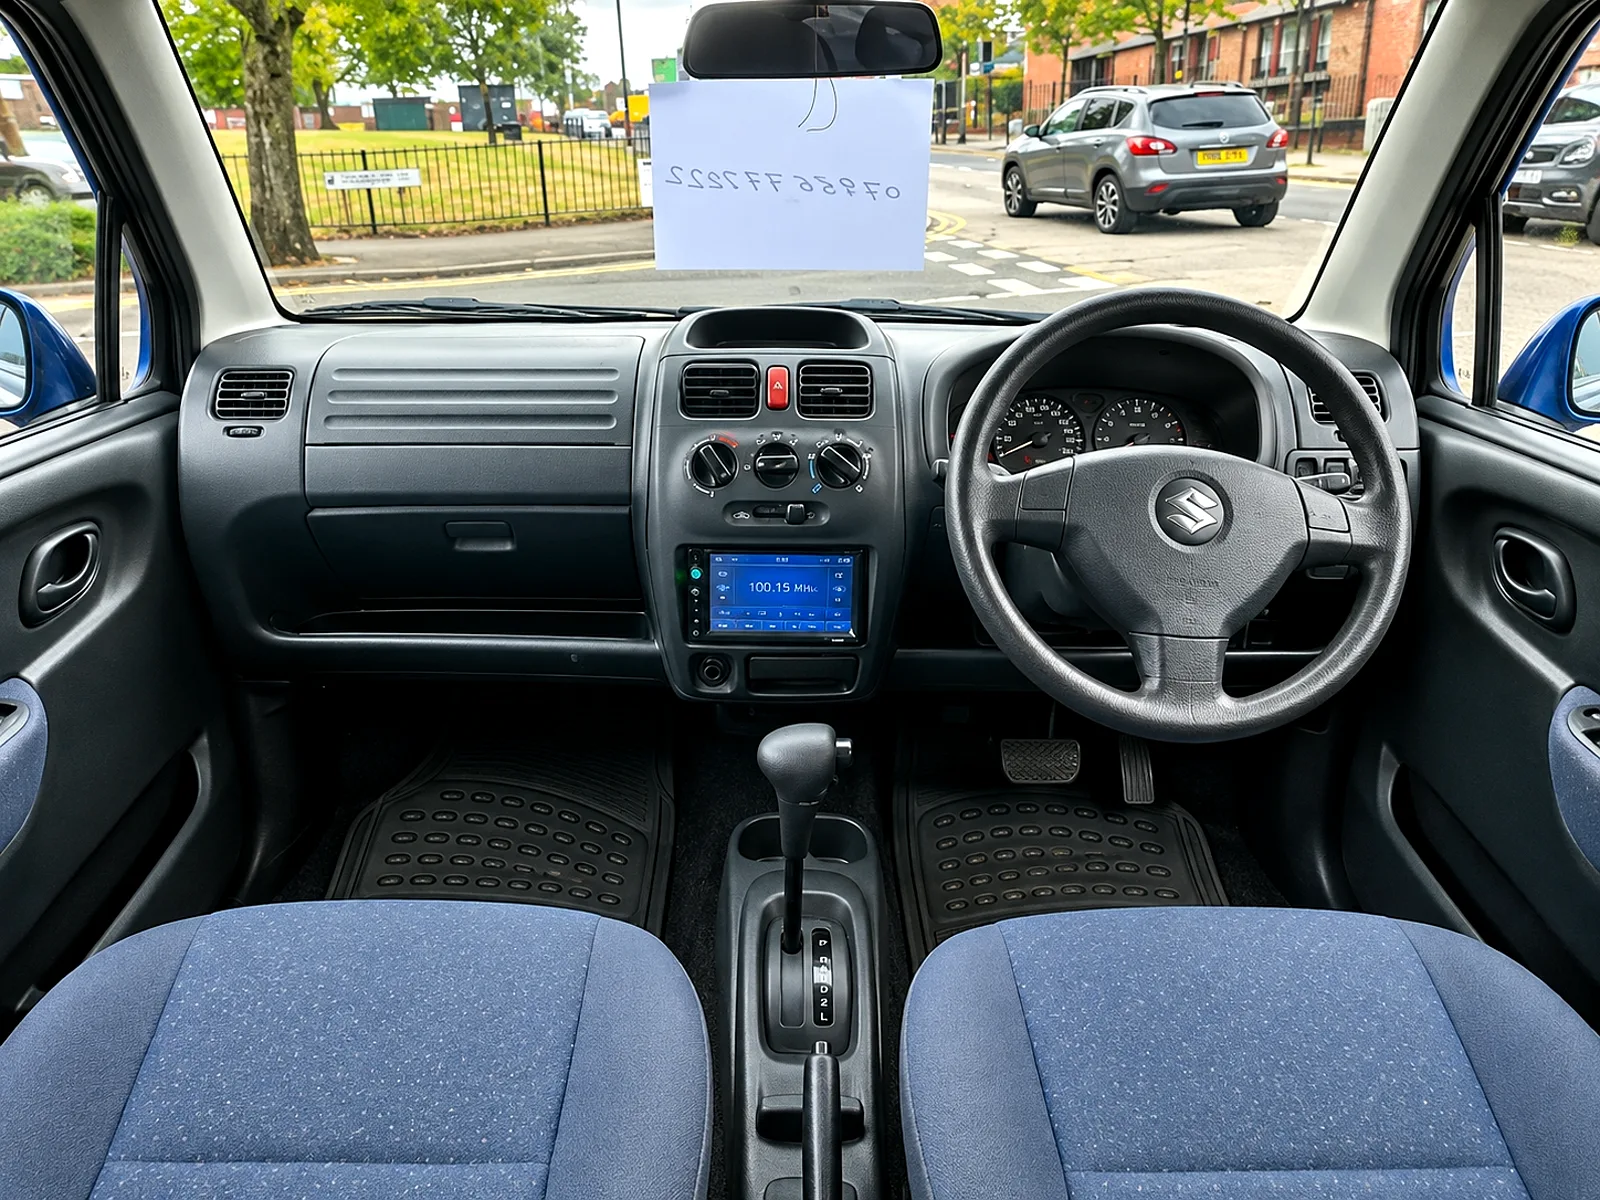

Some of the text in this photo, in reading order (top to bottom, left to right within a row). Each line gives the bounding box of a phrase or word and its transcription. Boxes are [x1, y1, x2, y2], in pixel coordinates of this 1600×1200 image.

[748, 581, 790, 593] 100.15
[820, 998, 828, 1007] 2
[820, 1012, 828, 1021] L
